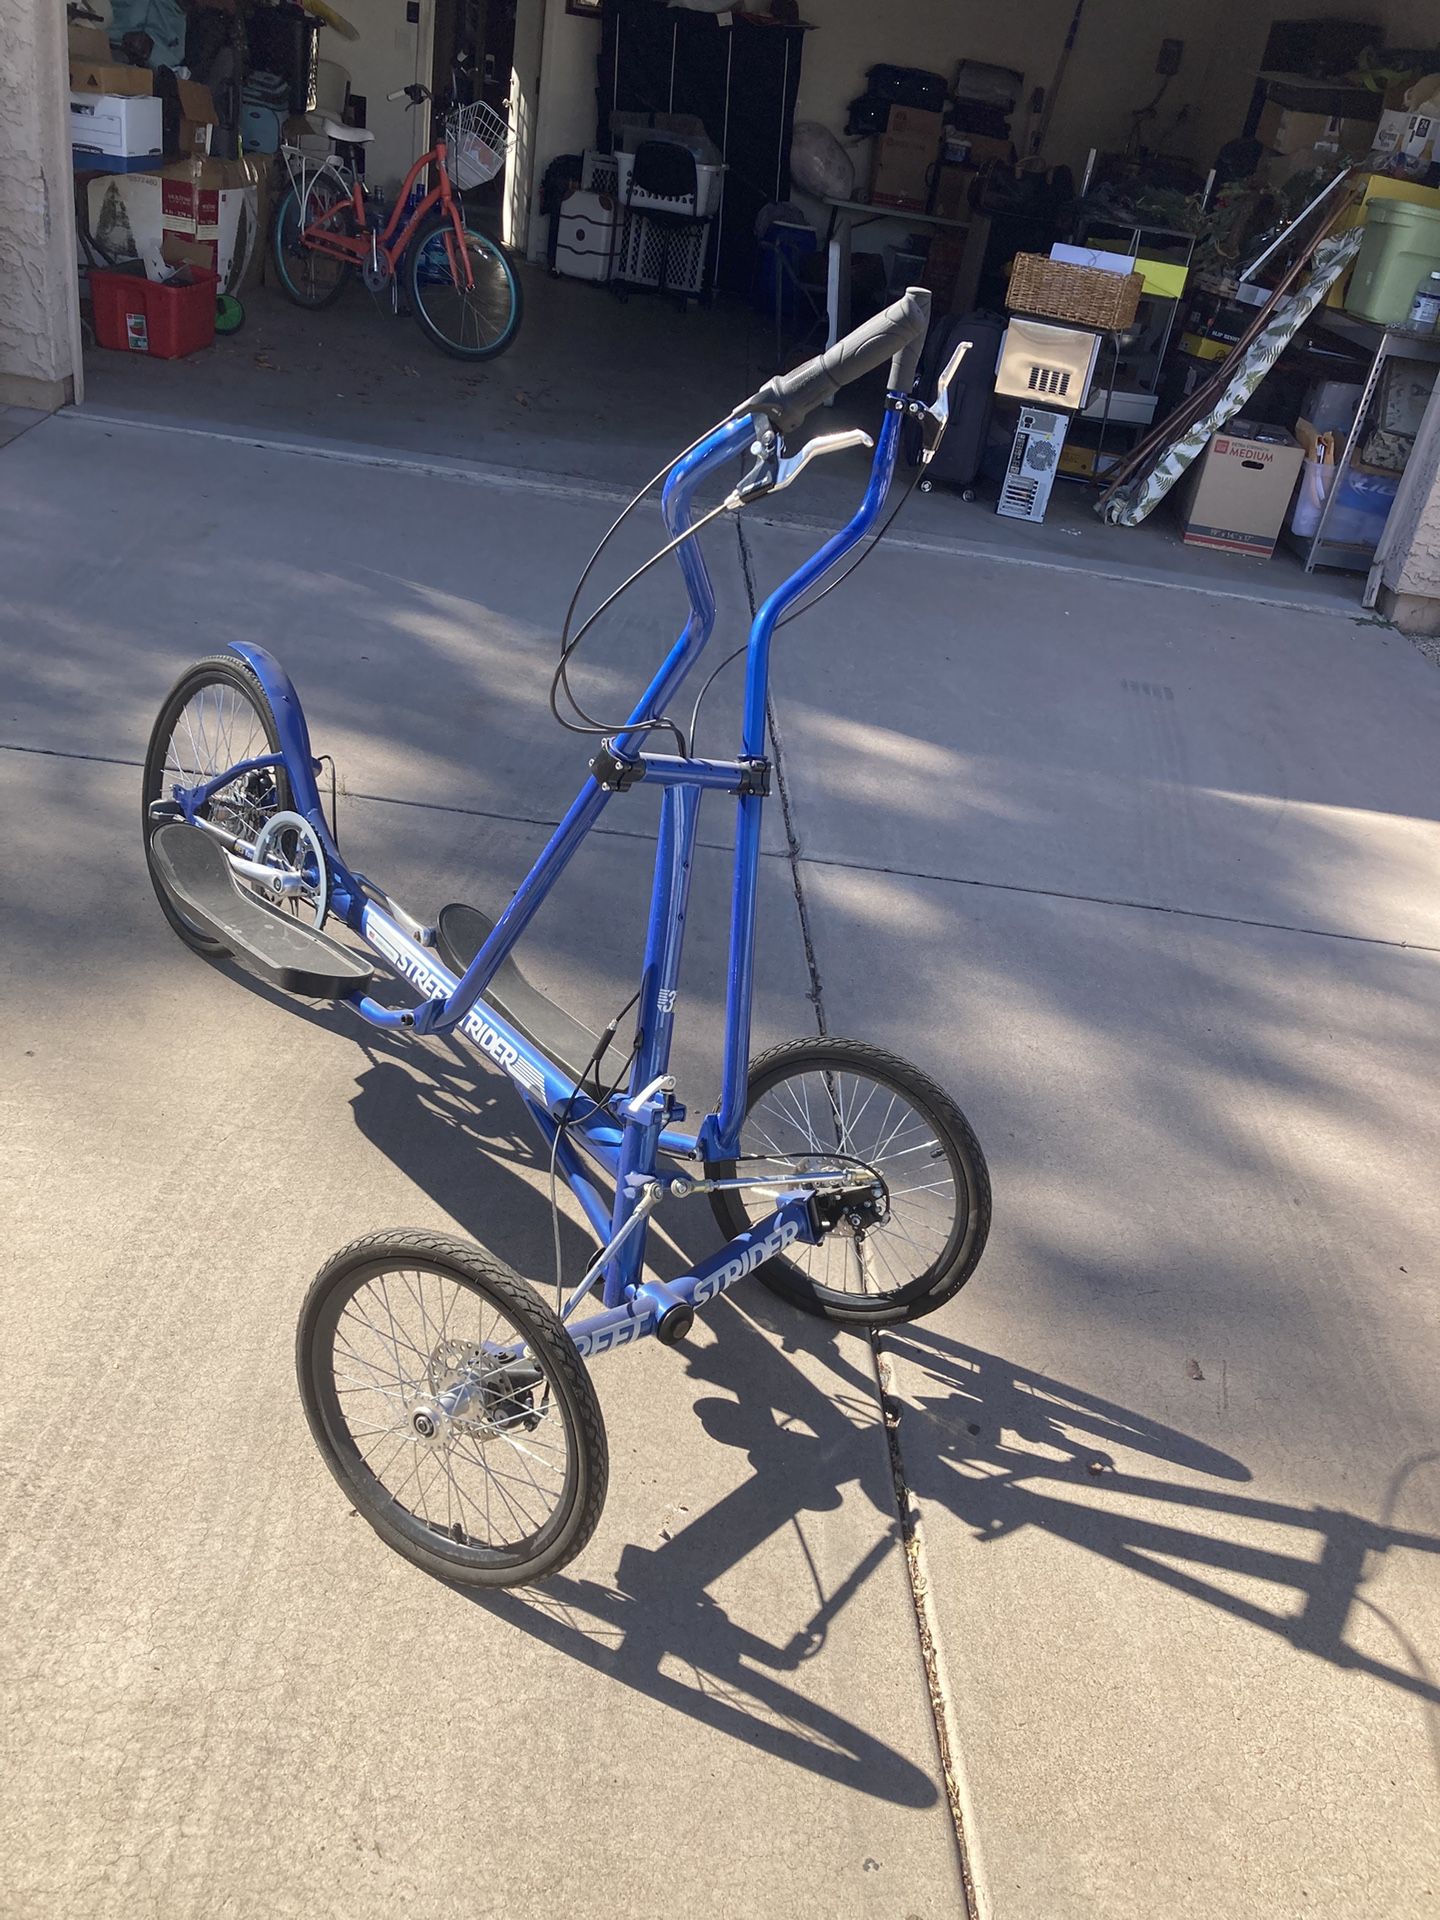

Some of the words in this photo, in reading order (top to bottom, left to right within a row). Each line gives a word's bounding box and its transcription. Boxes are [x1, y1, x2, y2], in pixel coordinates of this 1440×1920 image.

[1223, 332, 1241, 342] RESIST
[1229, 447, 1274, 463] MEDIUM
[395, 953, 453, 1000] STREE
[458, 1008, 519, 1070] TRIDER
[573, 1311, 652, 1358] REET
[692, 1220, 799, 1311] STRIDER
